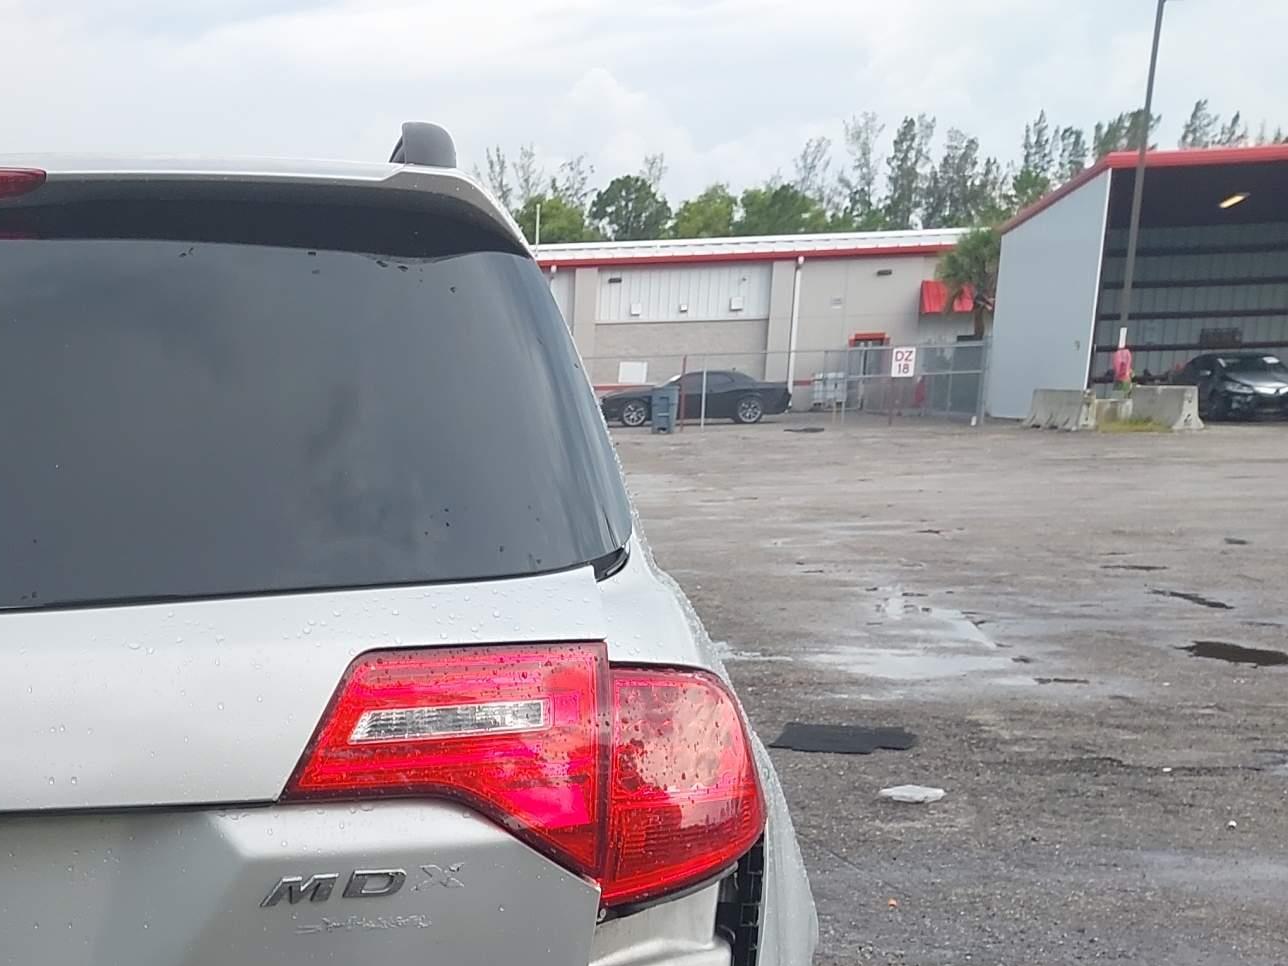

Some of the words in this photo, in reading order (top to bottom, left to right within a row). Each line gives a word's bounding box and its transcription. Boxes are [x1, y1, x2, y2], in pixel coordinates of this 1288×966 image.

[895, 350, 913, 362] DZ
[897, 363, 910, 375] 18
[259, 862, 465, 908] MDX
